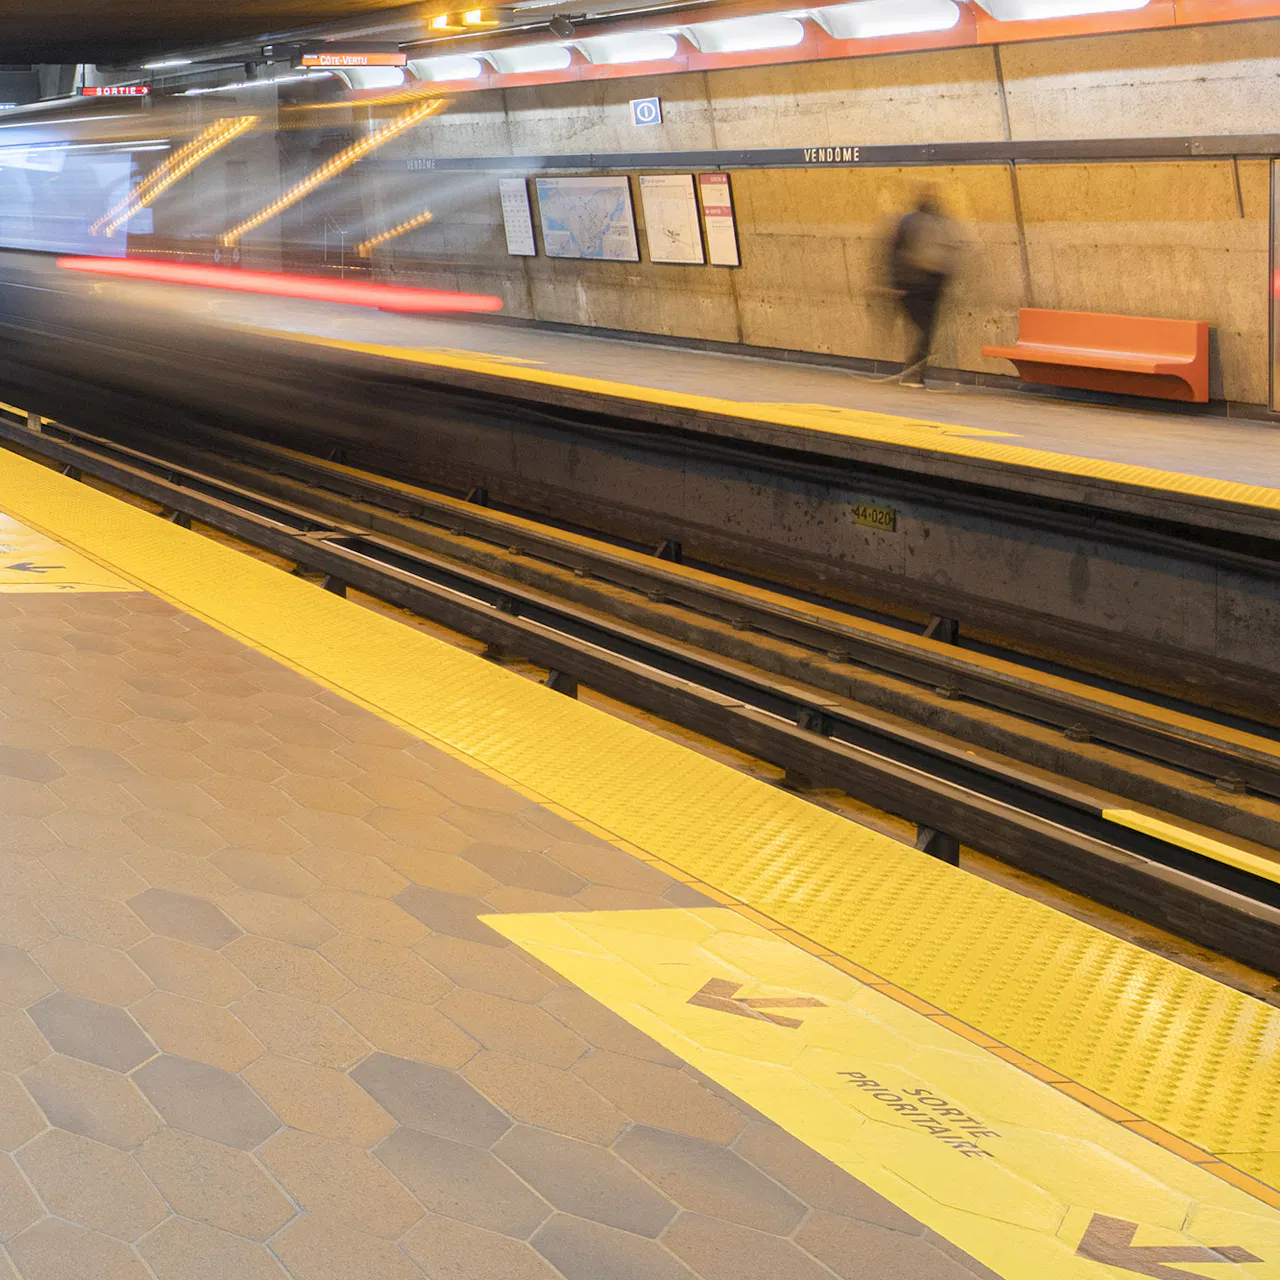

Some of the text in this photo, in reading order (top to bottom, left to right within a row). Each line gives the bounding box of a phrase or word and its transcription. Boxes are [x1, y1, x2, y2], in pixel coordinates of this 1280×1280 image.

[320, 55, 368, 65] CÔTE-VERTU
[96, 87, 136, 95] SORTIE
[803, 147, 860, 162] VENDÔME
[836, 1071, 995, 1158] PRIORITAIRE
[902, 1088, 1002, 1138] SORTIE
